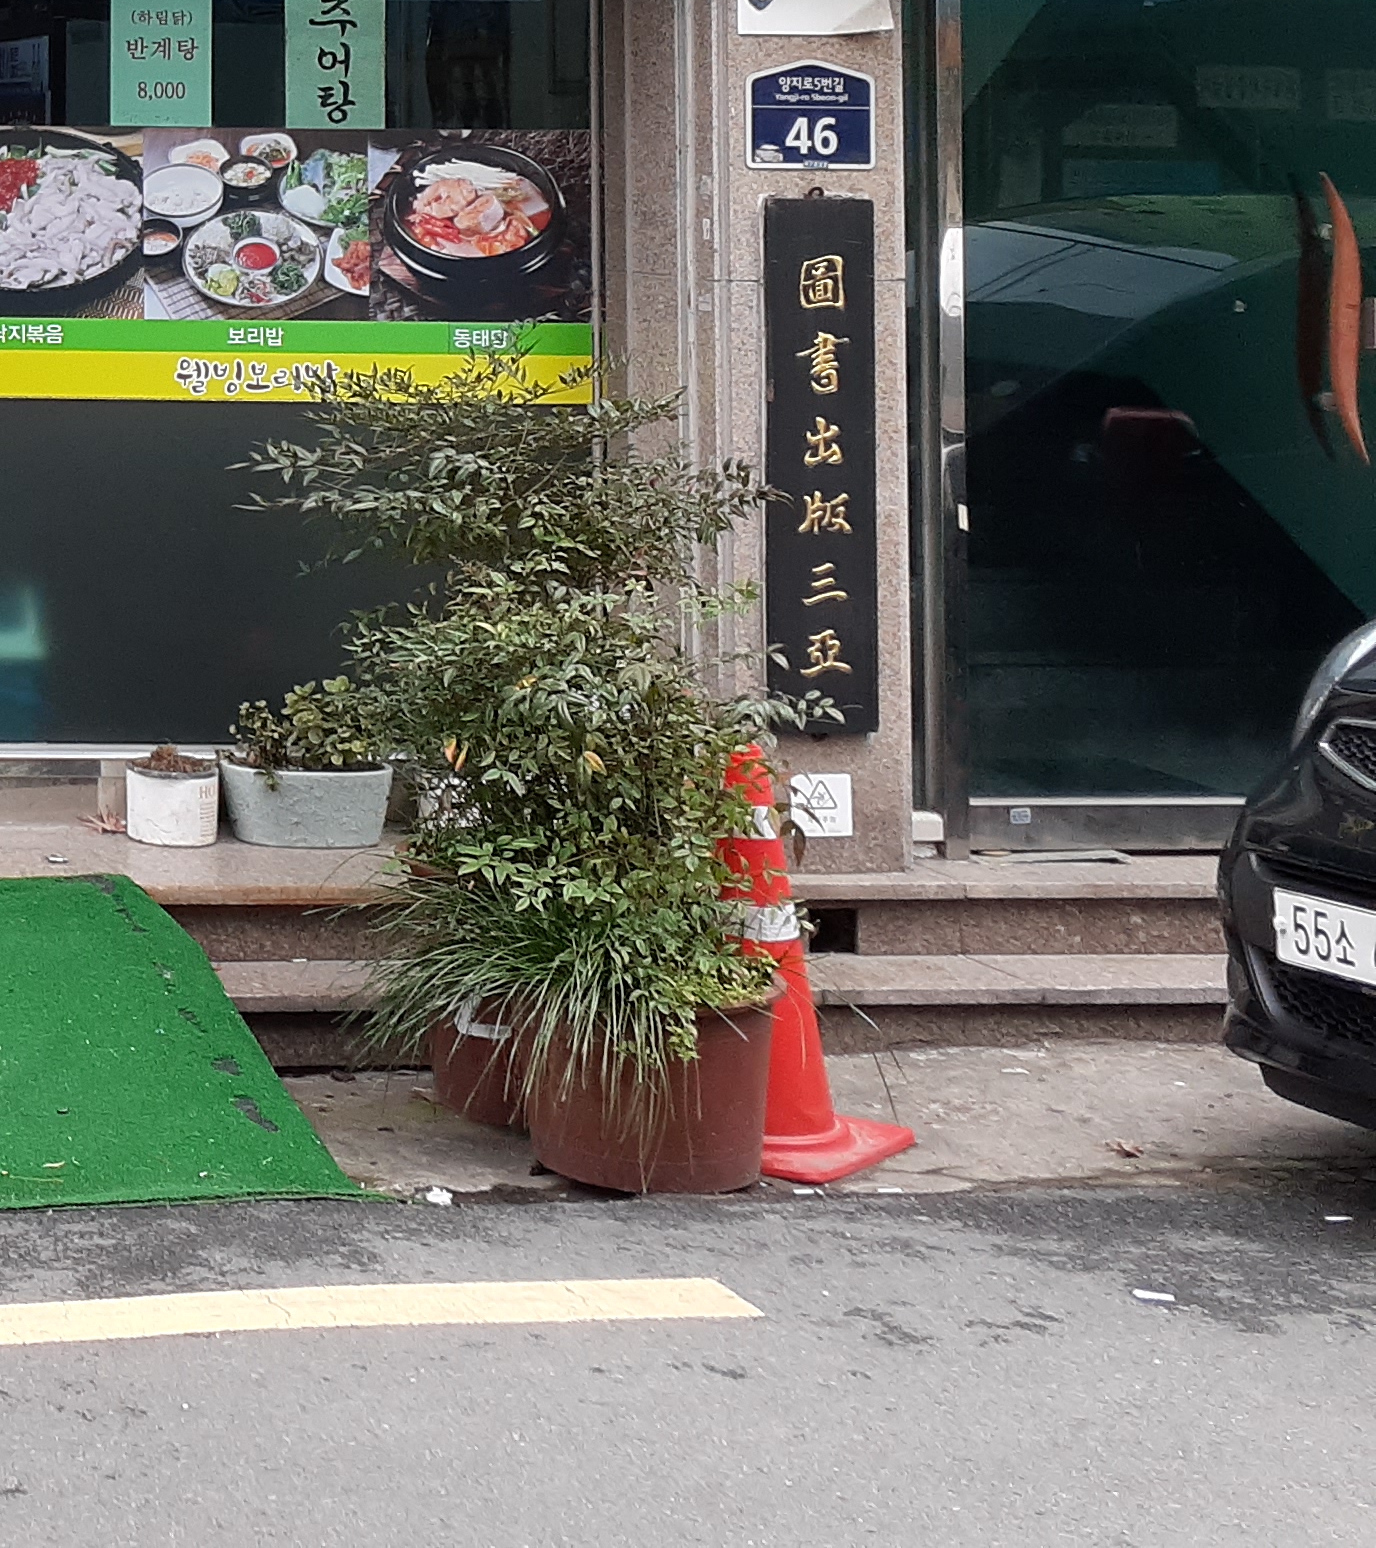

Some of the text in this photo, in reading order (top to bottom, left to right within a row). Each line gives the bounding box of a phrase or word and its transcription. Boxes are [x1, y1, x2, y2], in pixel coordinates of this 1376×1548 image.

[125, 36, 200, 62] 반계탕
[136, 81, 187, 102] 8,000
[778, 76, 845, 93] 양지로5번길
[784, 116, 839, 156] 46
[225, 326, 285, 348] 보리밥
[1291, 904, 1357, 969] 55소
